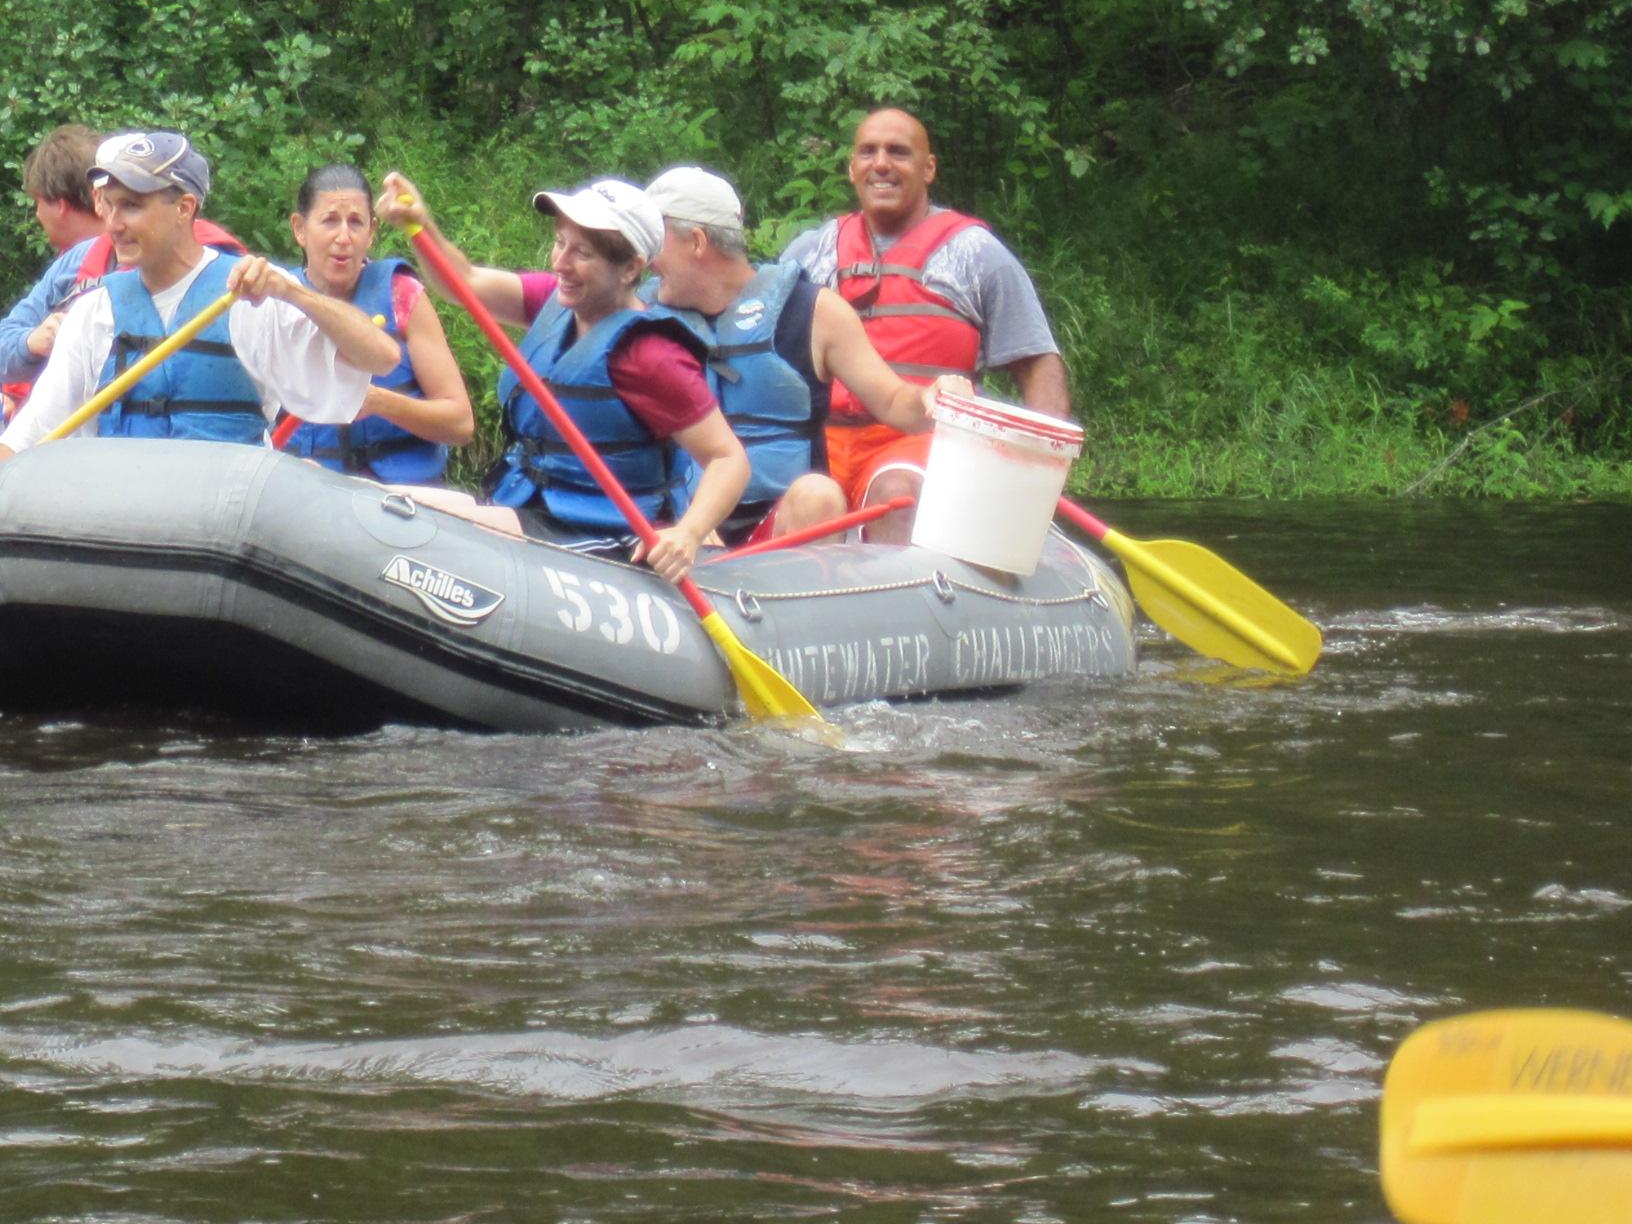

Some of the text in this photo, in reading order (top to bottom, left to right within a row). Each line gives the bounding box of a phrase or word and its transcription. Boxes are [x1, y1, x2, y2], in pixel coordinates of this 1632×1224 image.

[384, 558, 475, 608] Achilles
[542, 565, 681, 655] 530
[767, 633, 931, 698] HITEWATER
